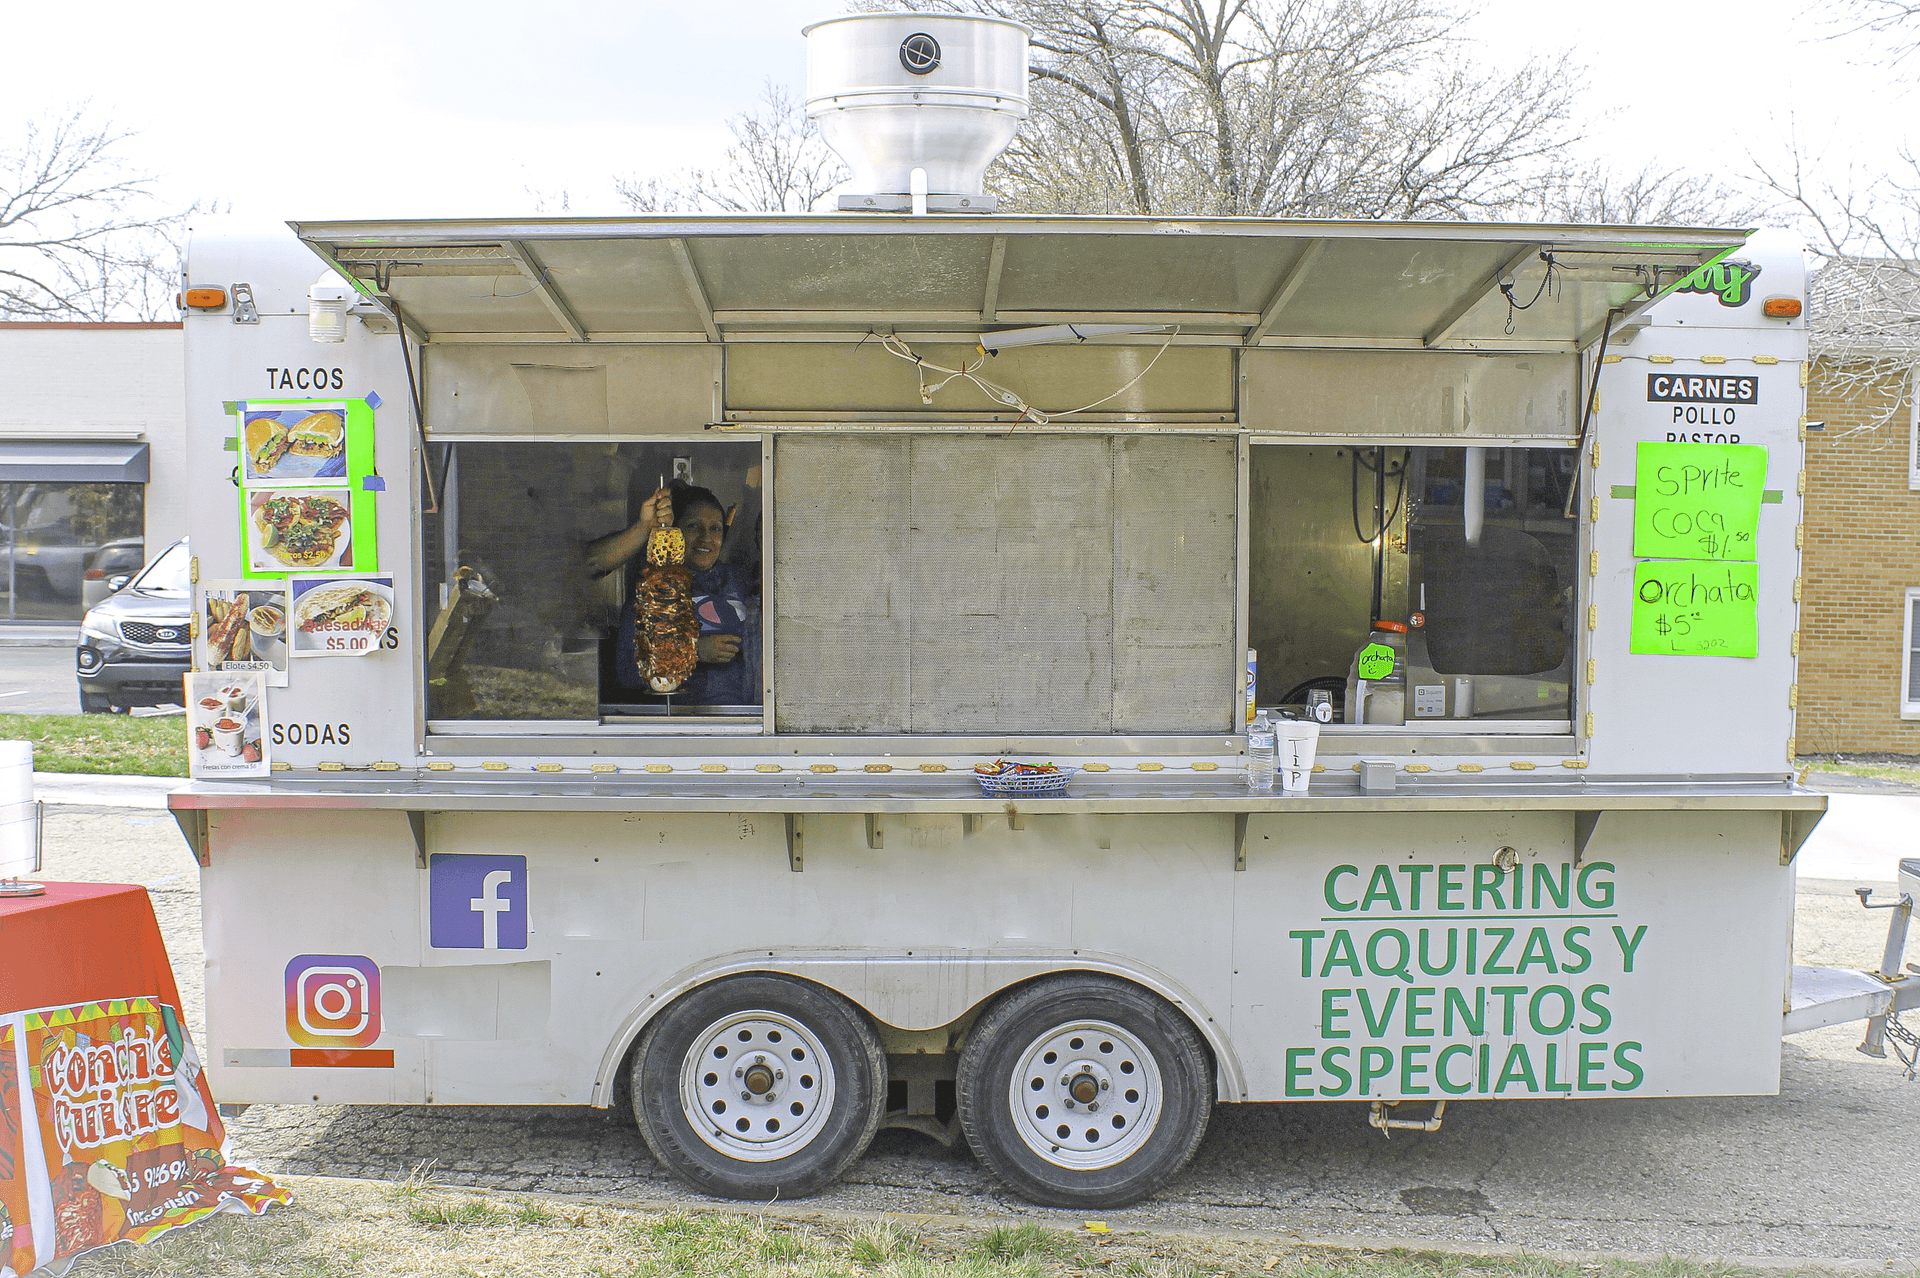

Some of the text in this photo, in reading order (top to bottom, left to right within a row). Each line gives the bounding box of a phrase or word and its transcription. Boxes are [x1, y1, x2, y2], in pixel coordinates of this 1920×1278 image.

[266, 368, 344, 390] TACOS
[1654, 376, 1754, 399] CARNES
[1673, 406, 1736, 425] POLLO
[303, 616, 388, 633] Quesadillas
[326, 636, 369, 650] $5.00
[225, 661, 270, 670] Elote $4.50
[272, 723, 350, 745] SODAS
[1324, 862, 1616, 912] CATERING
[1289, 925, 1649, 984] TAQUIZAS Y
[1321, 984, 1613, 1039] EVENTOS
[1285, 1041, 1645, 1097] ESPECIALES
